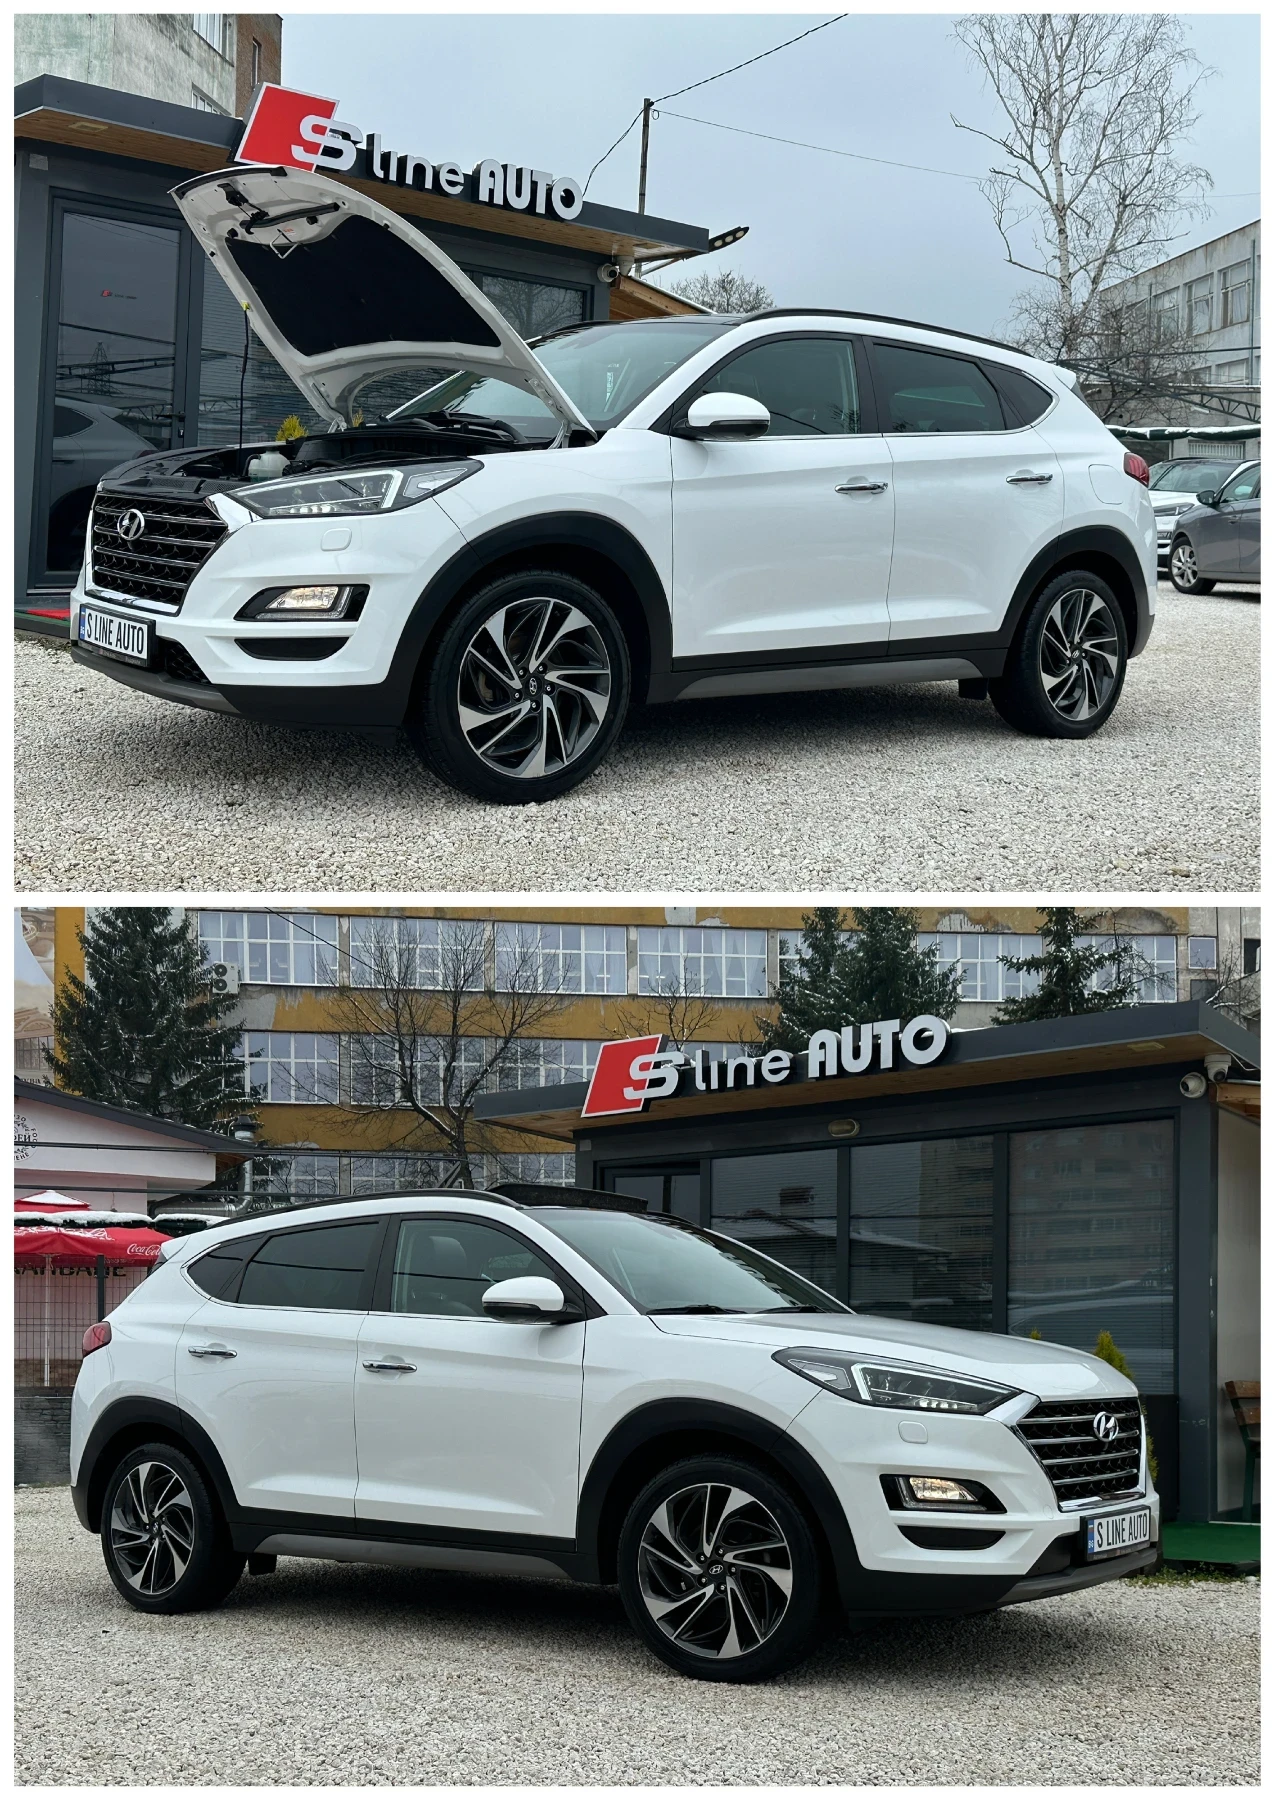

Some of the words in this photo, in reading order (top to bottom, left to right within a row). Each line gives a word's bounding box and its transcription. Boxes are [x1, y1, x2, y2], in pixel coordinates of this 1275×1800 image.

[291, 114, 363, 171] S
[370, 132, 465, 195] line
[476, 157, 584, 221] AUTO
[87, 612, 93, 639] S
[94, 615, 114, 646] LINE
[115, 621, 144, 655] AUTO
[622, 1050, 686, 1101] S
[694, 1048, 792, 1092] line
[807, 1013, 950, 1079] AUTO
[1097, 1521, 1104, 1548] S
[1106, 1518, 1126, 1546] LINE
[1128, 1513, 1148, 1541] AUTO
